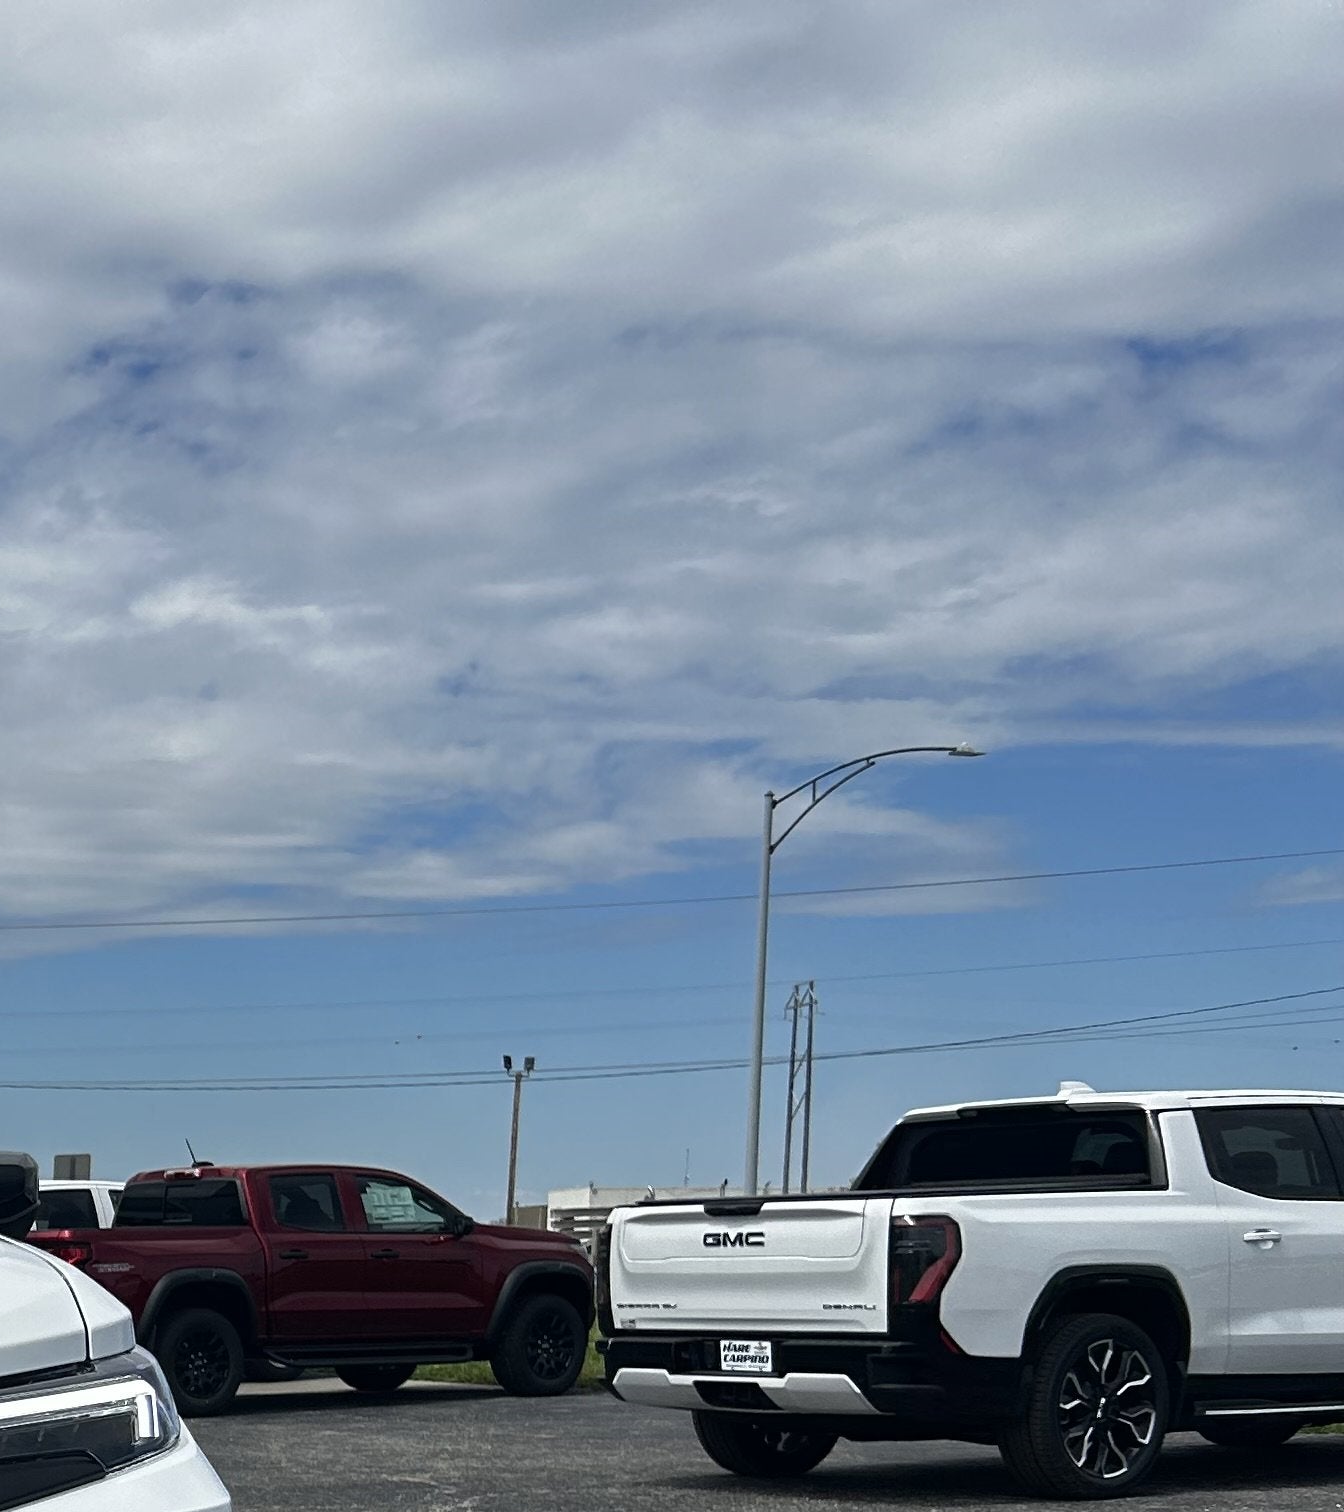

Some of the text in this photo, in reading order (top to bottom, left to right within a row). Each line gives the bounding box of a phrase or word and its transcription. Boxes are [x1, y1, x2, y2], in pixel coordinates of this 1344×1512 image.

[703, 1231, 766, 1248] GMC
[723, 1342, 751, 1353] HARE
[723, 1354, 770, 1364] CARPINO
